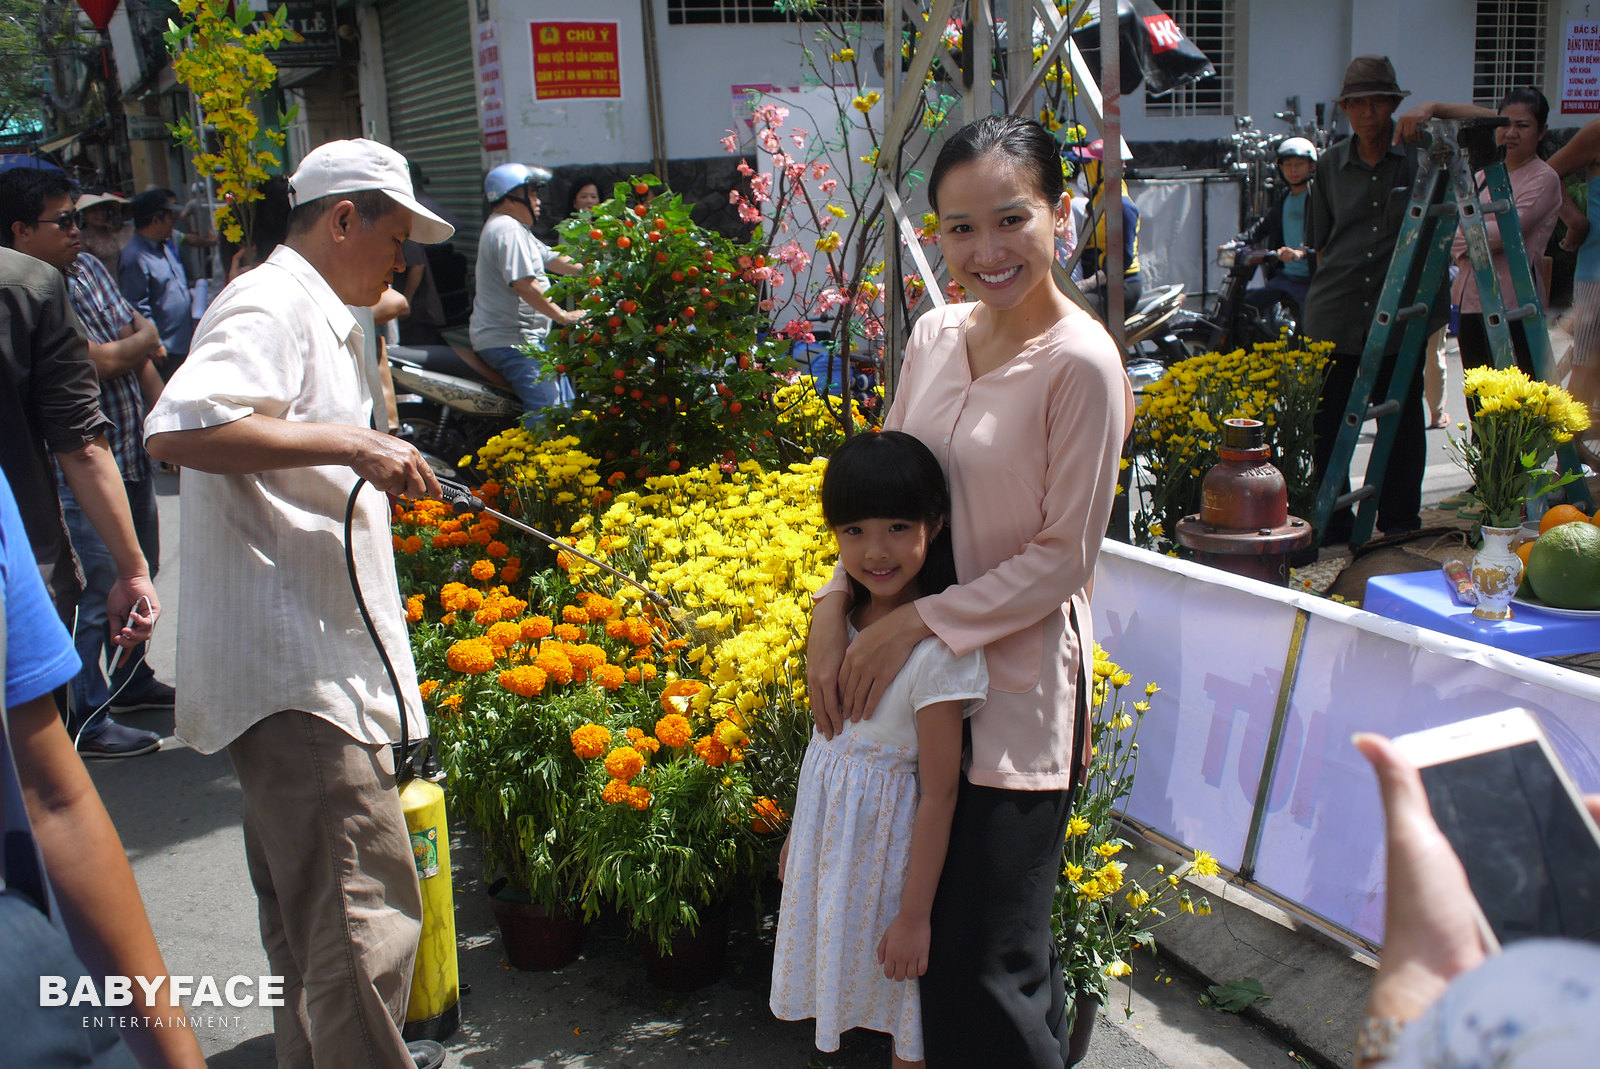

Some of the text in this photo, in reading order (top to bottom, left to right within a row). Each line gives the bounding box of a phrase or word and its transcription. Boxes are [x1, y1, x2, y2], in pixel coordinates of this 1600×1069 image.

[566, 27, 609, 41] CHÚ Ý
[1573, 24, 1589, 34] BÁC
